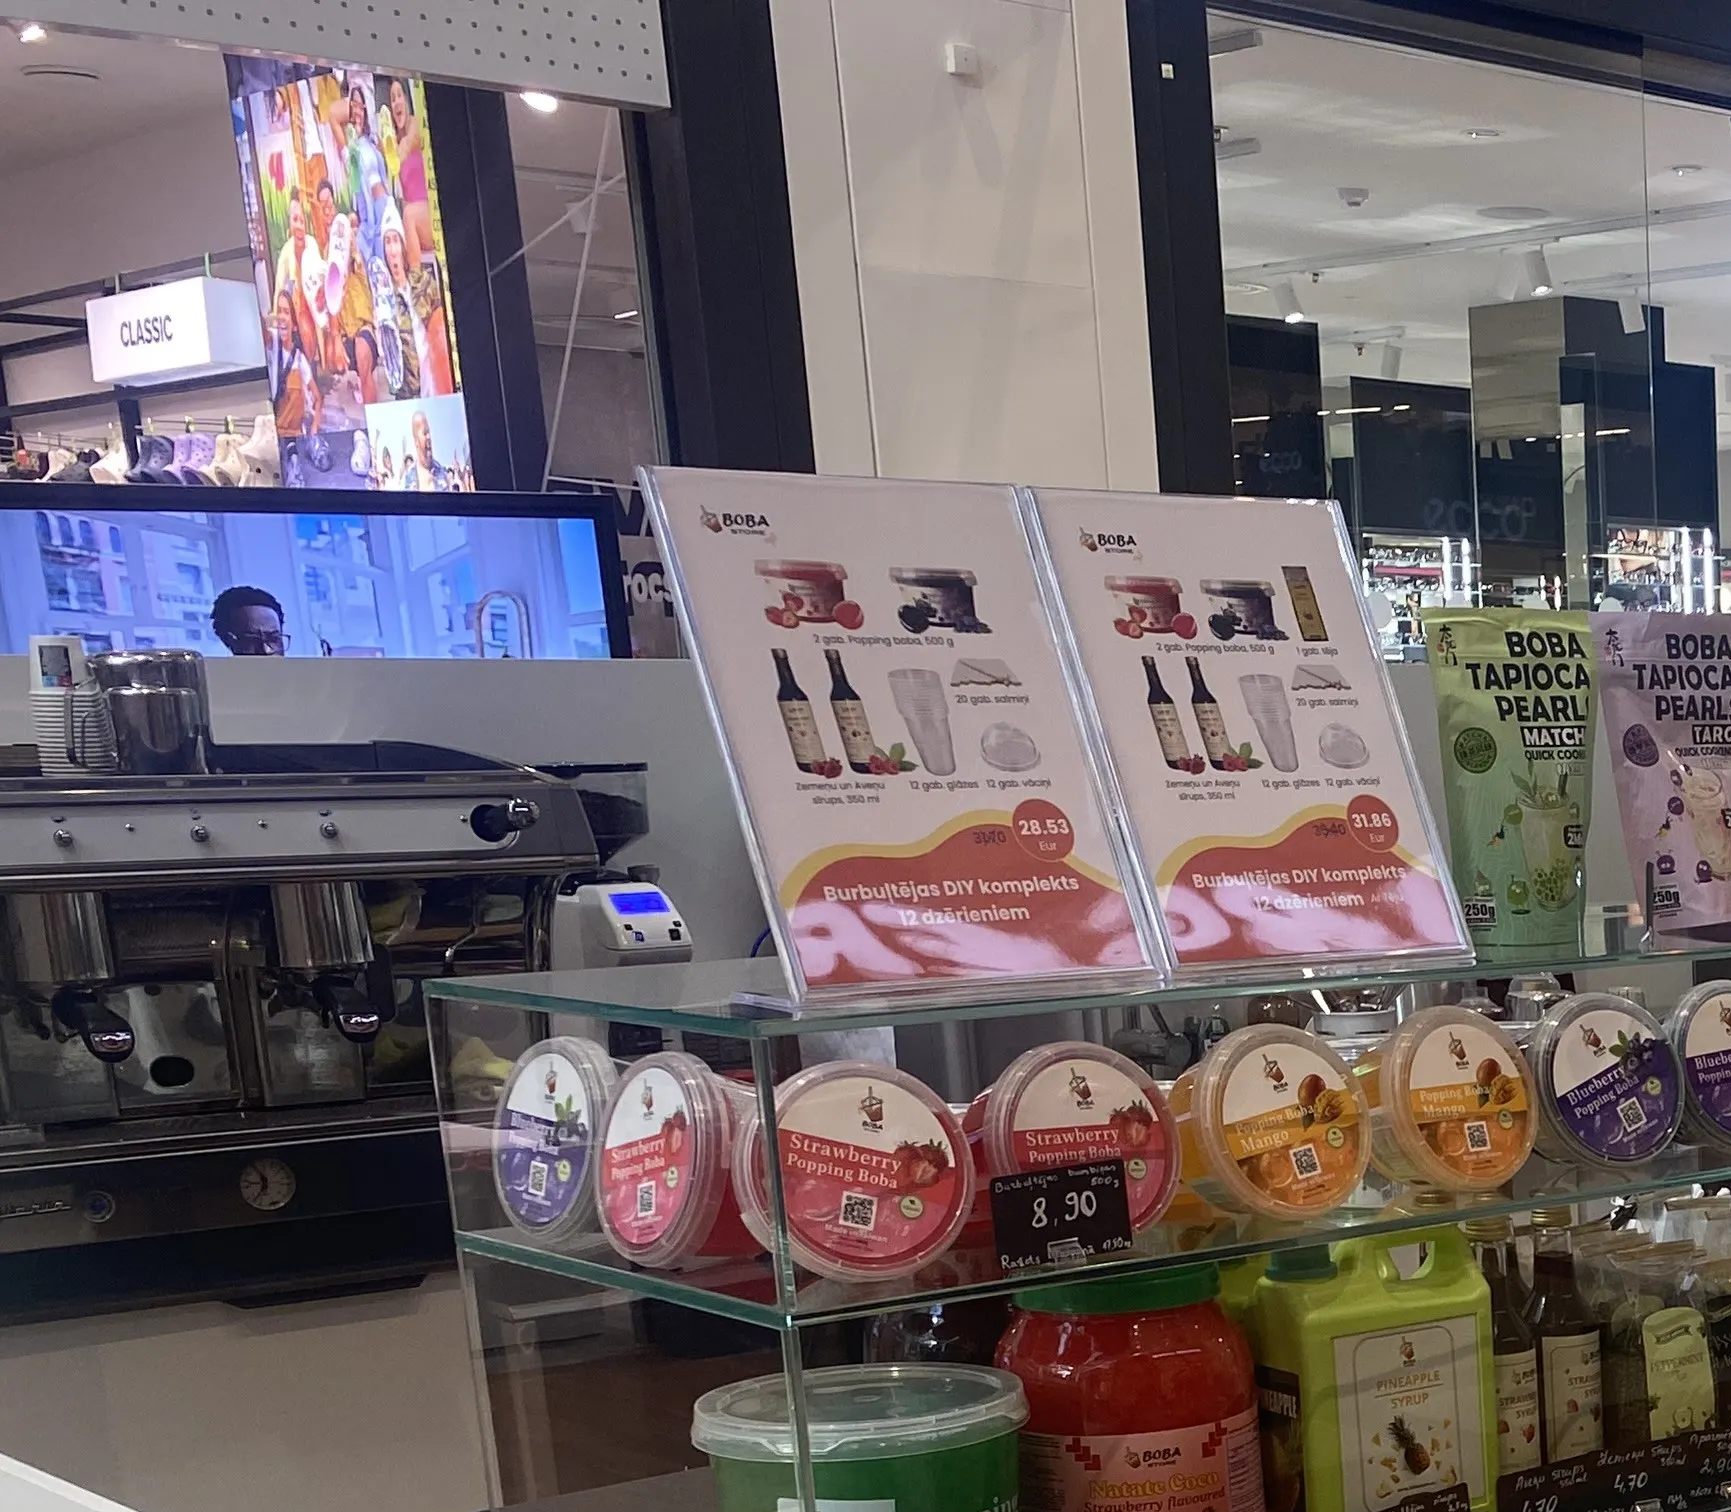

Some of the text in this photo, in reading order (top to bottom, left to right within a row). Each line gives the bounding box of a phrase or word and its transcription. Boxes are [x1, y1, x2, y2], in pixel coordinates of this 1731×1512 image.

[119, 313, 174, 348] CLASSIC
[722, 513, 770, 528] BOBA
[1097, 533, 1137, 547] BOBA
[814, 634, 820, 644] 2
[848, 635, 892, 648] Popping
[1156, 642, 1163, 651] 2
[1185, 643, 1222, 655] Popping
[1505, 631, 1589, 659] BOBA
[1465, 663, 1590, 690] TAPIOCA
[1525, 749, 1555, 761] QUICK
[1675, 747, 1699, 757] QUICK
[1018, 818, 1070, 836] 28.53
[1351, 813, 1392, 828] 31.86
[1038, 840, 1057, 852] Eur
[1369, 833, 1385, 843] Eur
[1191, 865, 1406, 890] Burbuļtējas DIY komplekts
[823, 875, 1080, 905] Burbuļtējas DIY komplekts
[1254, 892, 1365, 911] 12 dzērieniem
[1464, 903, 1495, 919] 250g
[899, 904, 1030, 926] 12 dzērieniem
[1420, 1084, 1490, 1103] Popping Boba
[1566, 1065, 1626, 1106] Blueberry
[1574, 1075, 1640, 1119] Popping Boba
[1234, 1105, 1315, 1136] Popping Boba
[1423, 1104, 1466, 1120] Mango
[1025, 1128, 1119, 1146] Strawberry
[1239, 1130, 1289, 1153] Mango
[610, 1138, 665, 1164] Strawberry
[790, 1133, 901, 1174] Strawberry
[1028, 1145, 1121, 1165] Popping Boba
[611, 1155, 665, 1181] Popping Boba
[786, 1152, 898, 1189] Popping Boba
[1031, 1191, 1097, 1228] 8,90
[1376, 1370, 1441, 1391] PINEAPPLE
[1391, 1392, 1430, 1409] SYRUP
[1142, 1446, 1181, 1462] BOBA
[1169, 1471, 1220, 1492] Coco
[1614, 1471, 1649, 1494] 4,70
[1167, 1486, 1225, 1510] flavoured
